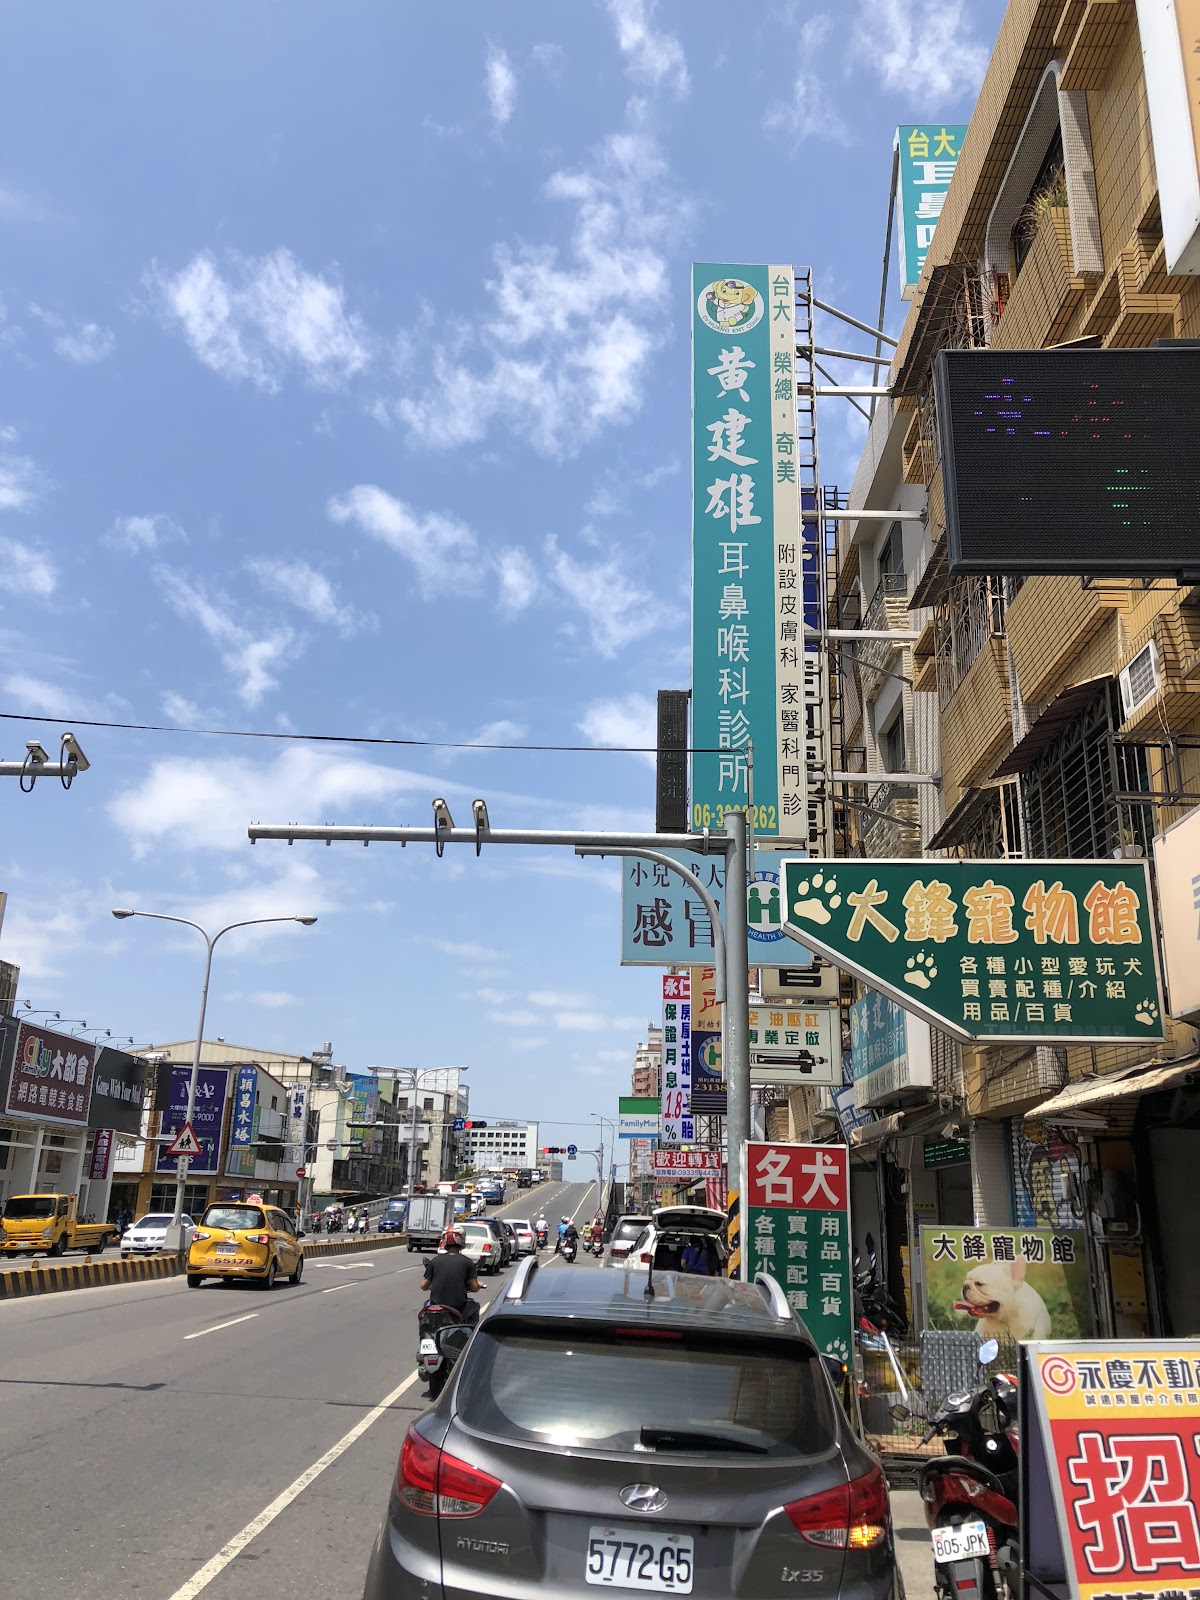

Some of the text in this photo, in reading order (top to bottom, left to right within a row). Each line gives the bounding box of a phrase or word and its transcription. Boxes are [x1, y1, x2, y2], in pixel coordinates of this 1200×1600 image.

[717, 542, 750, 793] 耳鼻喉科診所
[778, 543, 802, 816] 附設皮膚科 家醫科門診
[845, 877, 1144, 946] 大鋒寵物館
[959, 956, 1144, 977] 各種小型愛玩犬
[960, 979, 1127, 999] 買賣配種/介紹
[962, 1002, 1073, 1023] 用品/百貨
[50, 1049, 89, 1086] 大都會
[755, 1149, 840, 1206] 名犬
[932, 1233, 1075, 1263] 大鋒寵物館
[1076, 1359, 1200, 1390] 永慶不動
